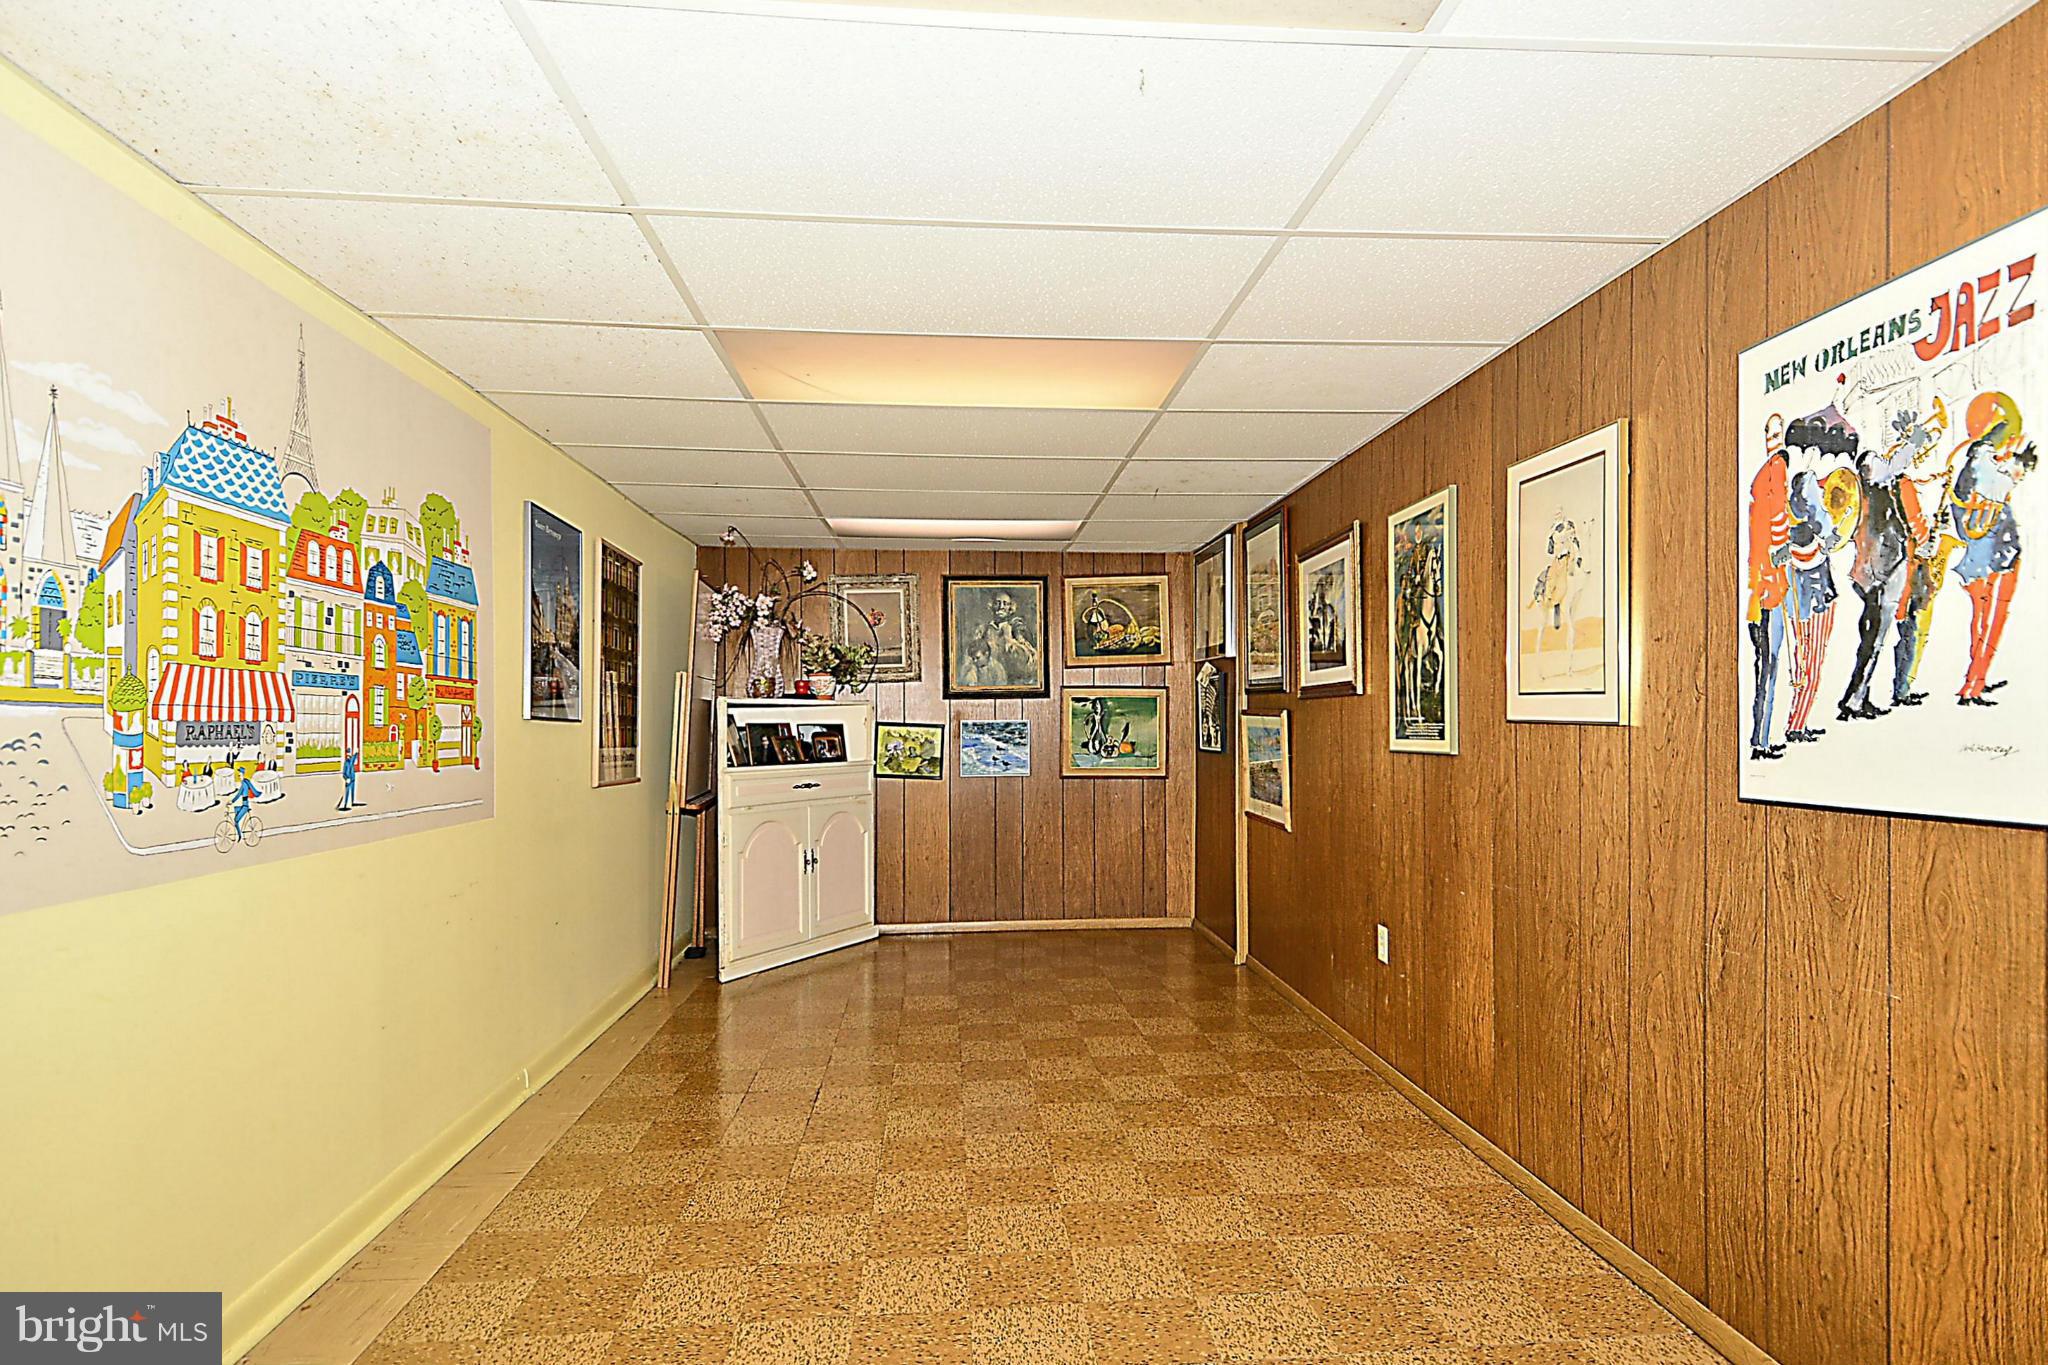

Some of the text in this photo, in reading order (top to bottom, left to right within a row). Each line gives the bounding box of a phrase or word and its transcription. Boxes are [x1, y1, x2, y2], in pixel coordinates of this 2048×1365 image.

[1764, 254, 2037, 395] NEW ORLEANS JAZZ
[295, 672, 358, 687] PIERRE'S
[185, 725, 256, 740] RAPHAEL'S
